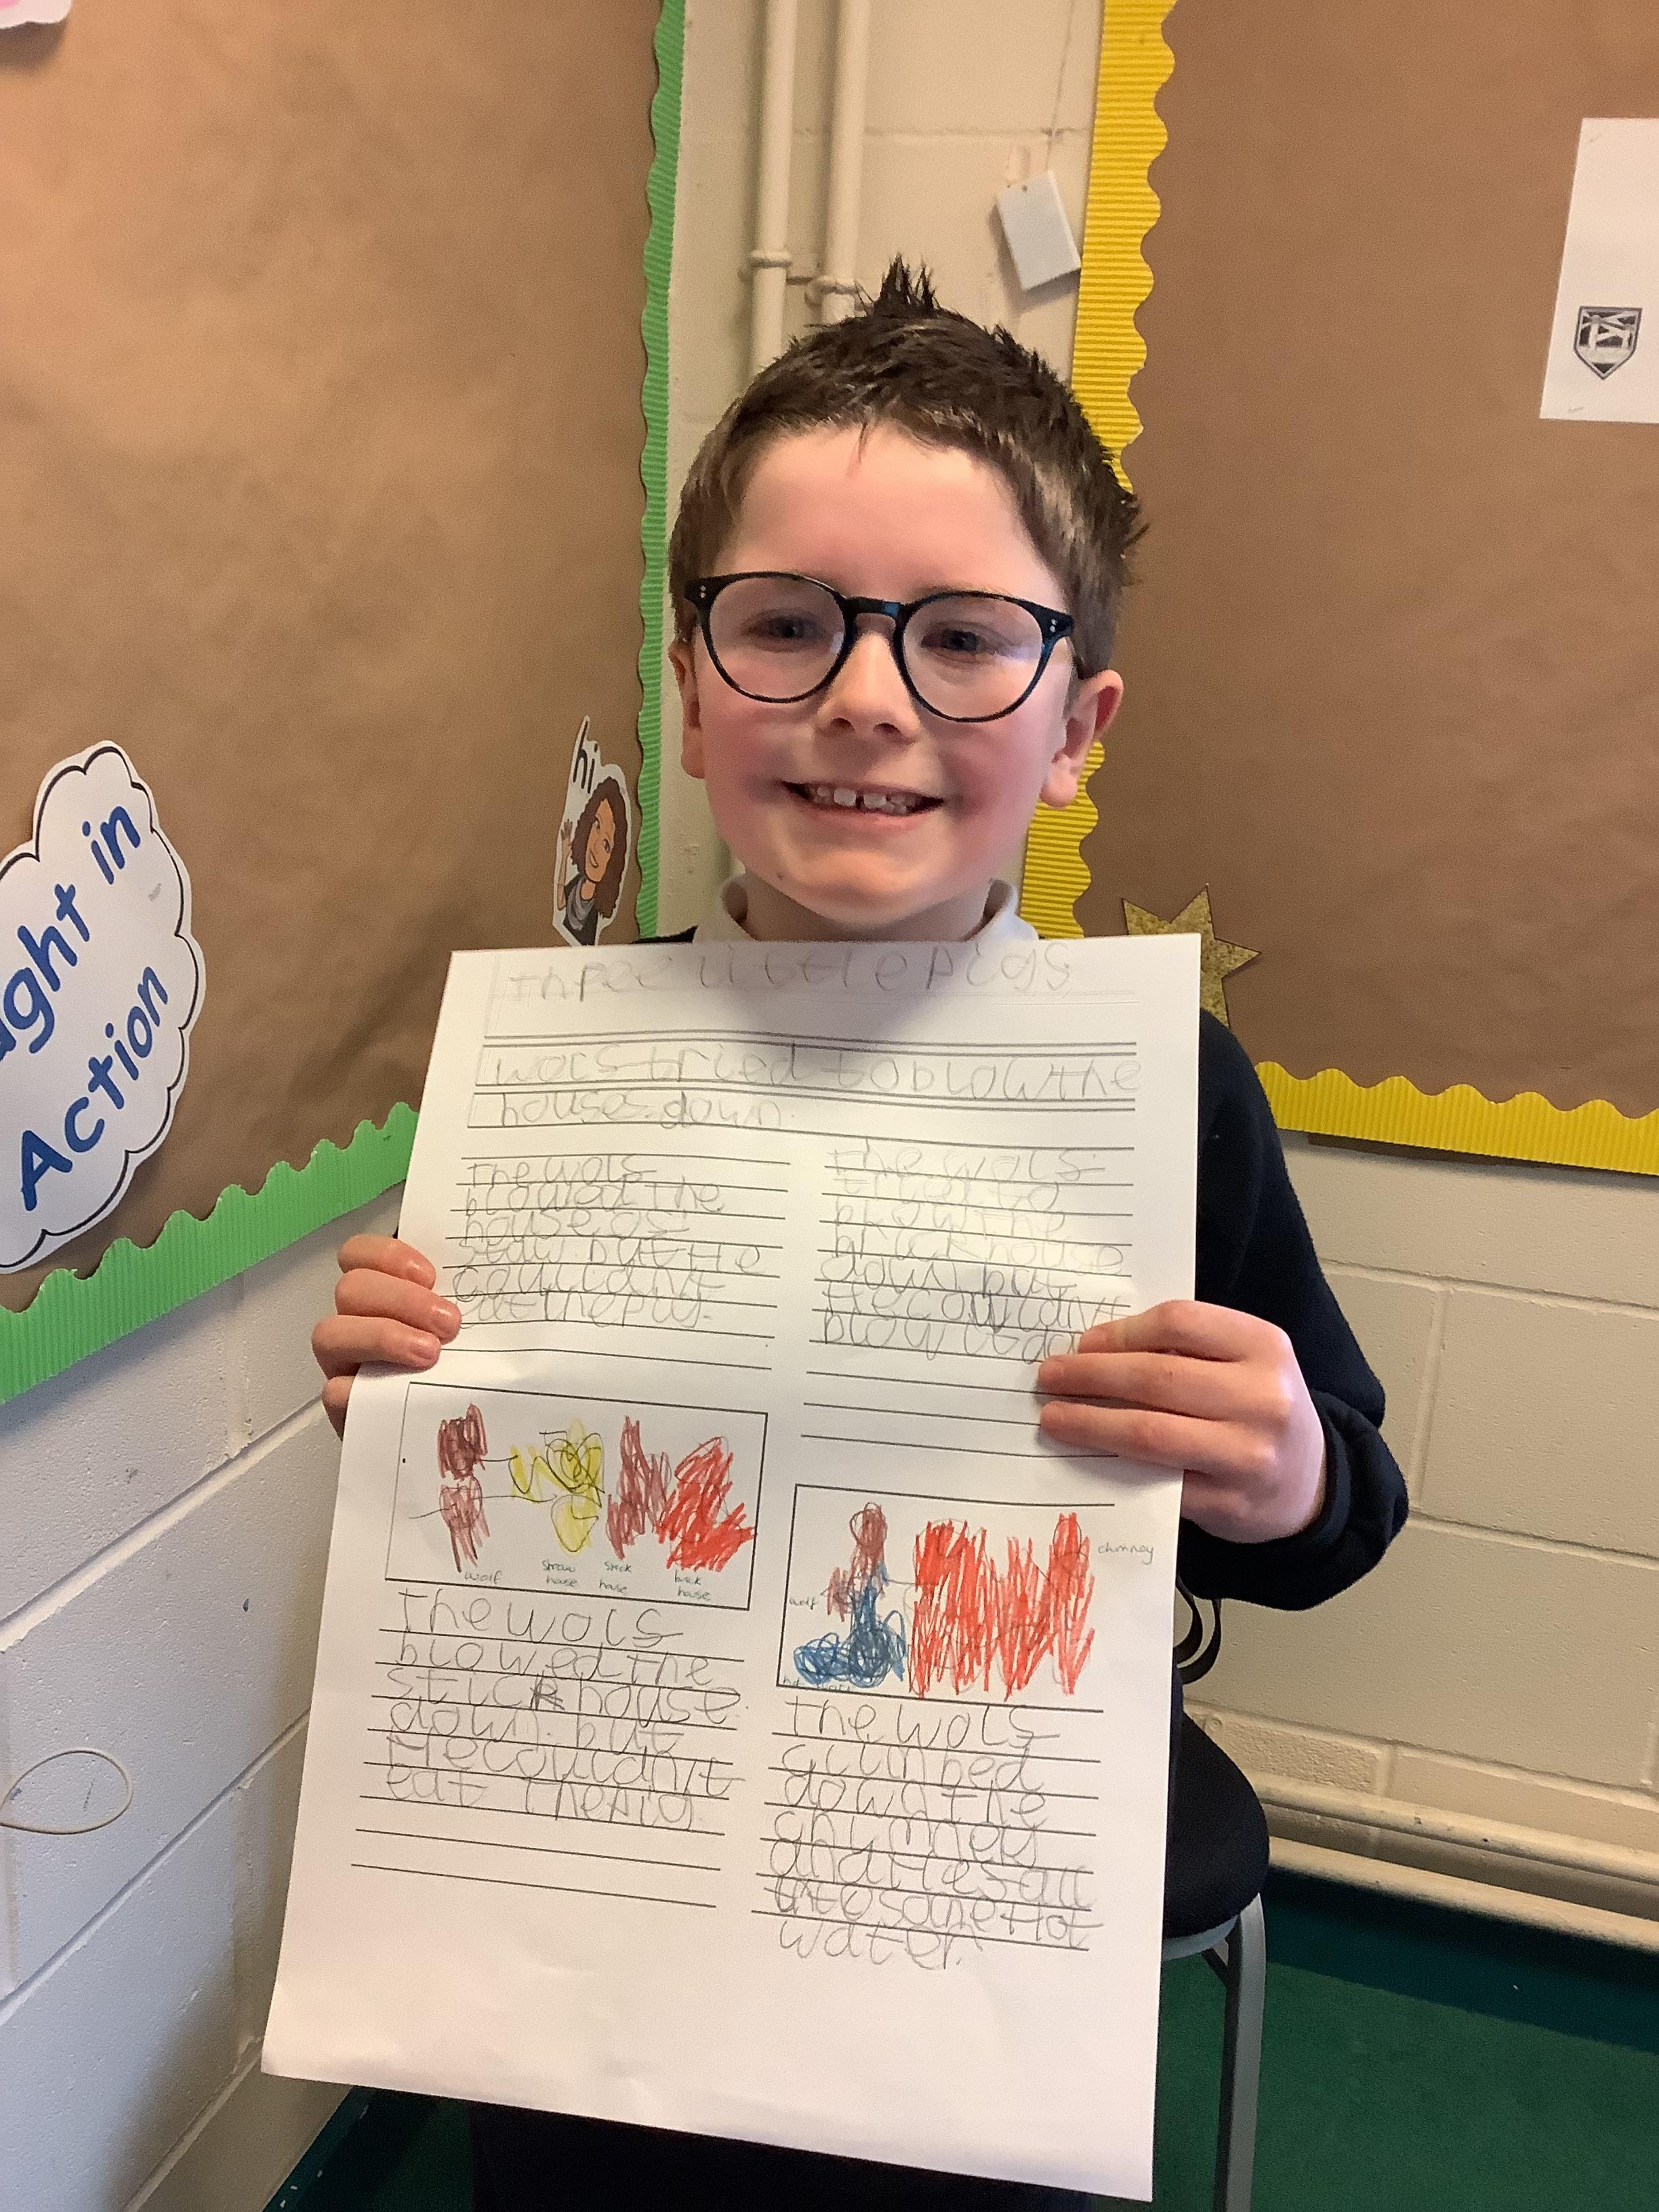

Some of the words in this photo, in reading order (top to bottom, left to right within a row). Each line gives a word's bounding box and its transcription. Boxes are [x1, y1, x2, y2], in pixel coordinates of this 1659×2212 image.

[573, 720, 598, 794] hi
[0, 883, 90, 1061] ght
[82, 805, 142, 885] in
[20, 966, 169, 1212] Action
[464, 1570, 502, 1584] wolf
